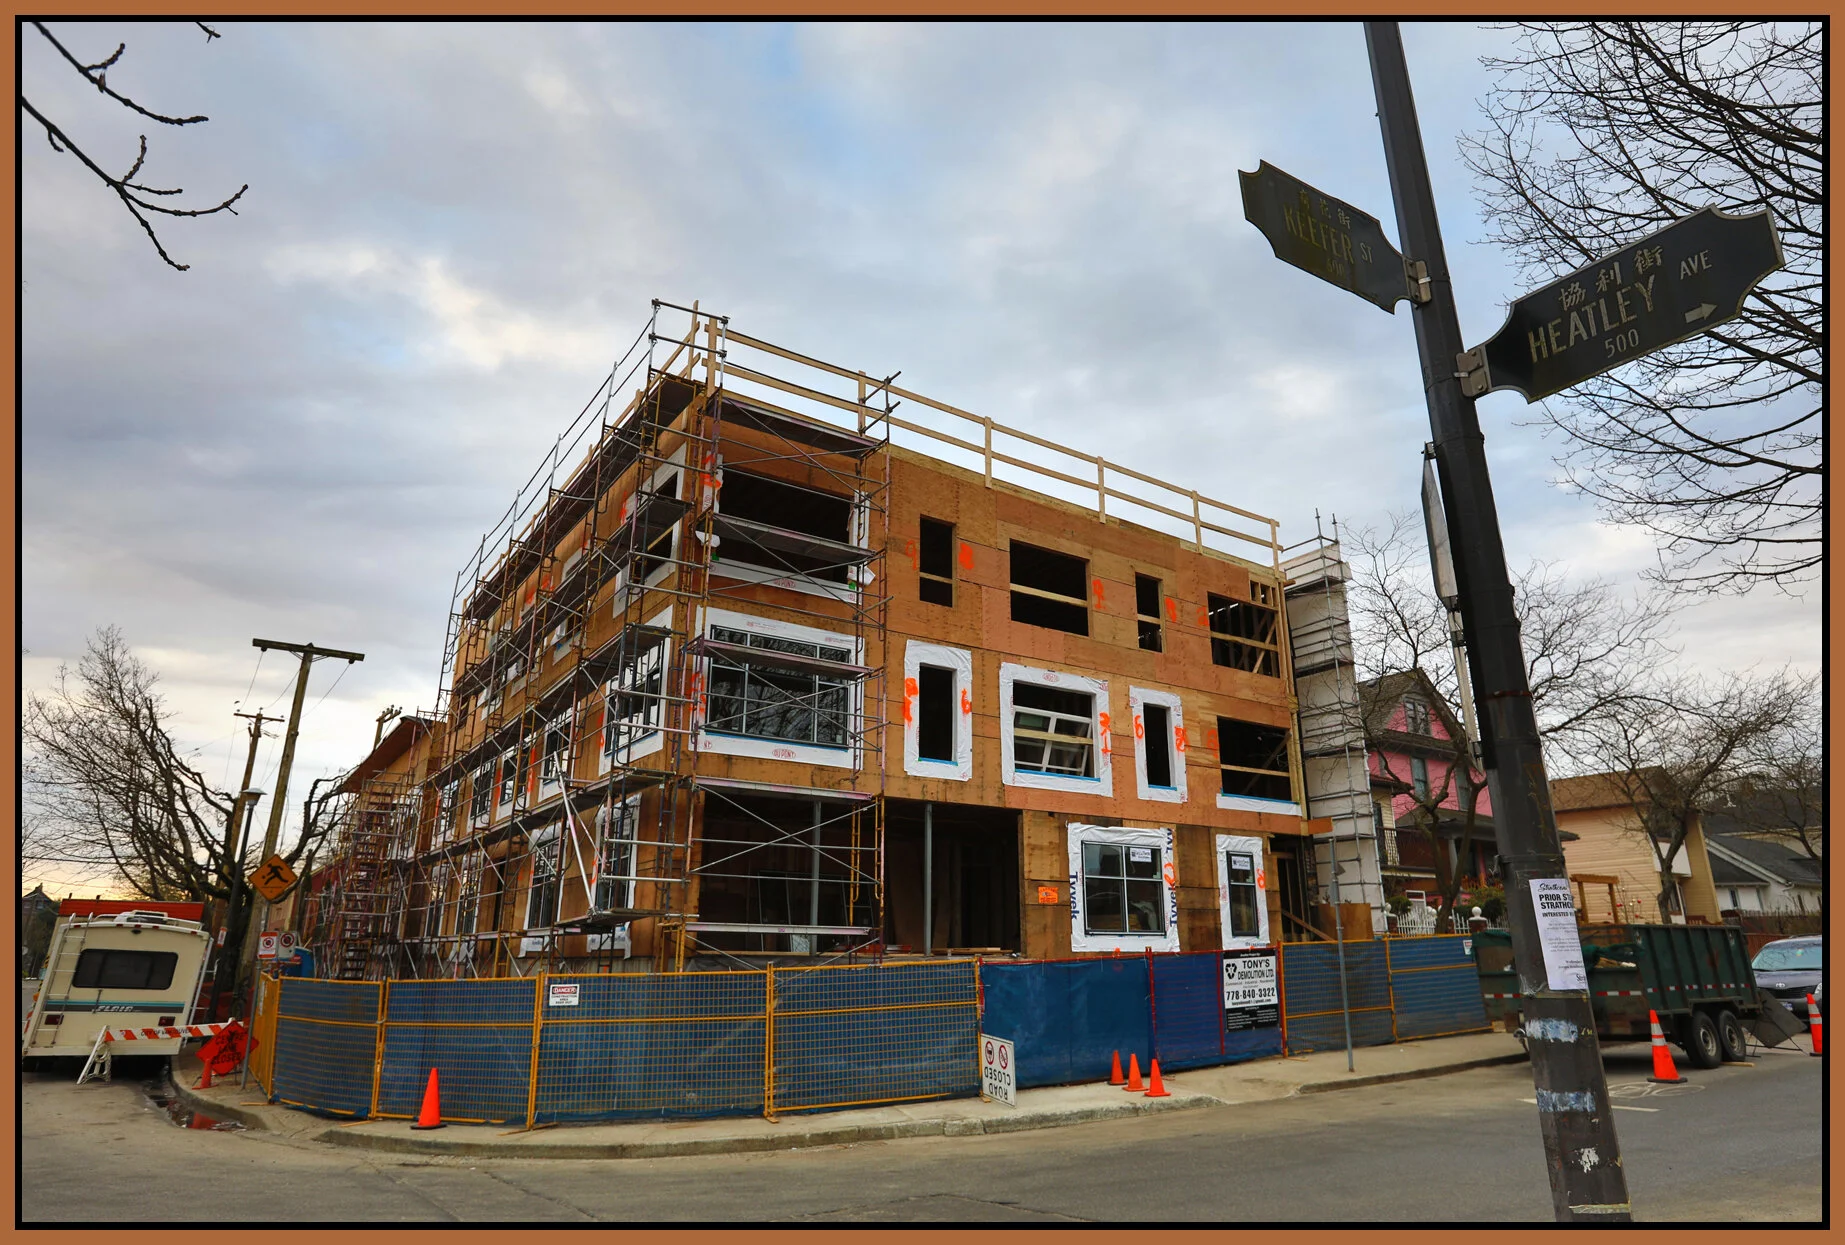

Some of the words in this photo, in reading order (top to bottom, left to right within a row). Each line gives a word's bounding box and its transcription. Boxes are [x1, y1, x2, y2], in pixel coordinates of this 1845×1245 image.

[1282, 202, 1354, 265] KEEFER
[1359, 241, 1374, 264] ST
[1527, 274, 1656, 364] HEATLEY
[1679, 250, 1713, 281] AVE
[1604, 328, 1640, 359] 500
[1069, 871, 1081, 921] Tyvek
[1538, 894, 1562, 902] PRIOR
[1242, 958, 1270, 970] TONY'S
[1237, 970, 1265, 981] DEMOLITION
[1226, 987, 1276, 1001] 778-840-3322
[984, 1066, 1011, 1086] CLOSED
[988, 1083, 1009, 1101] ROAD
